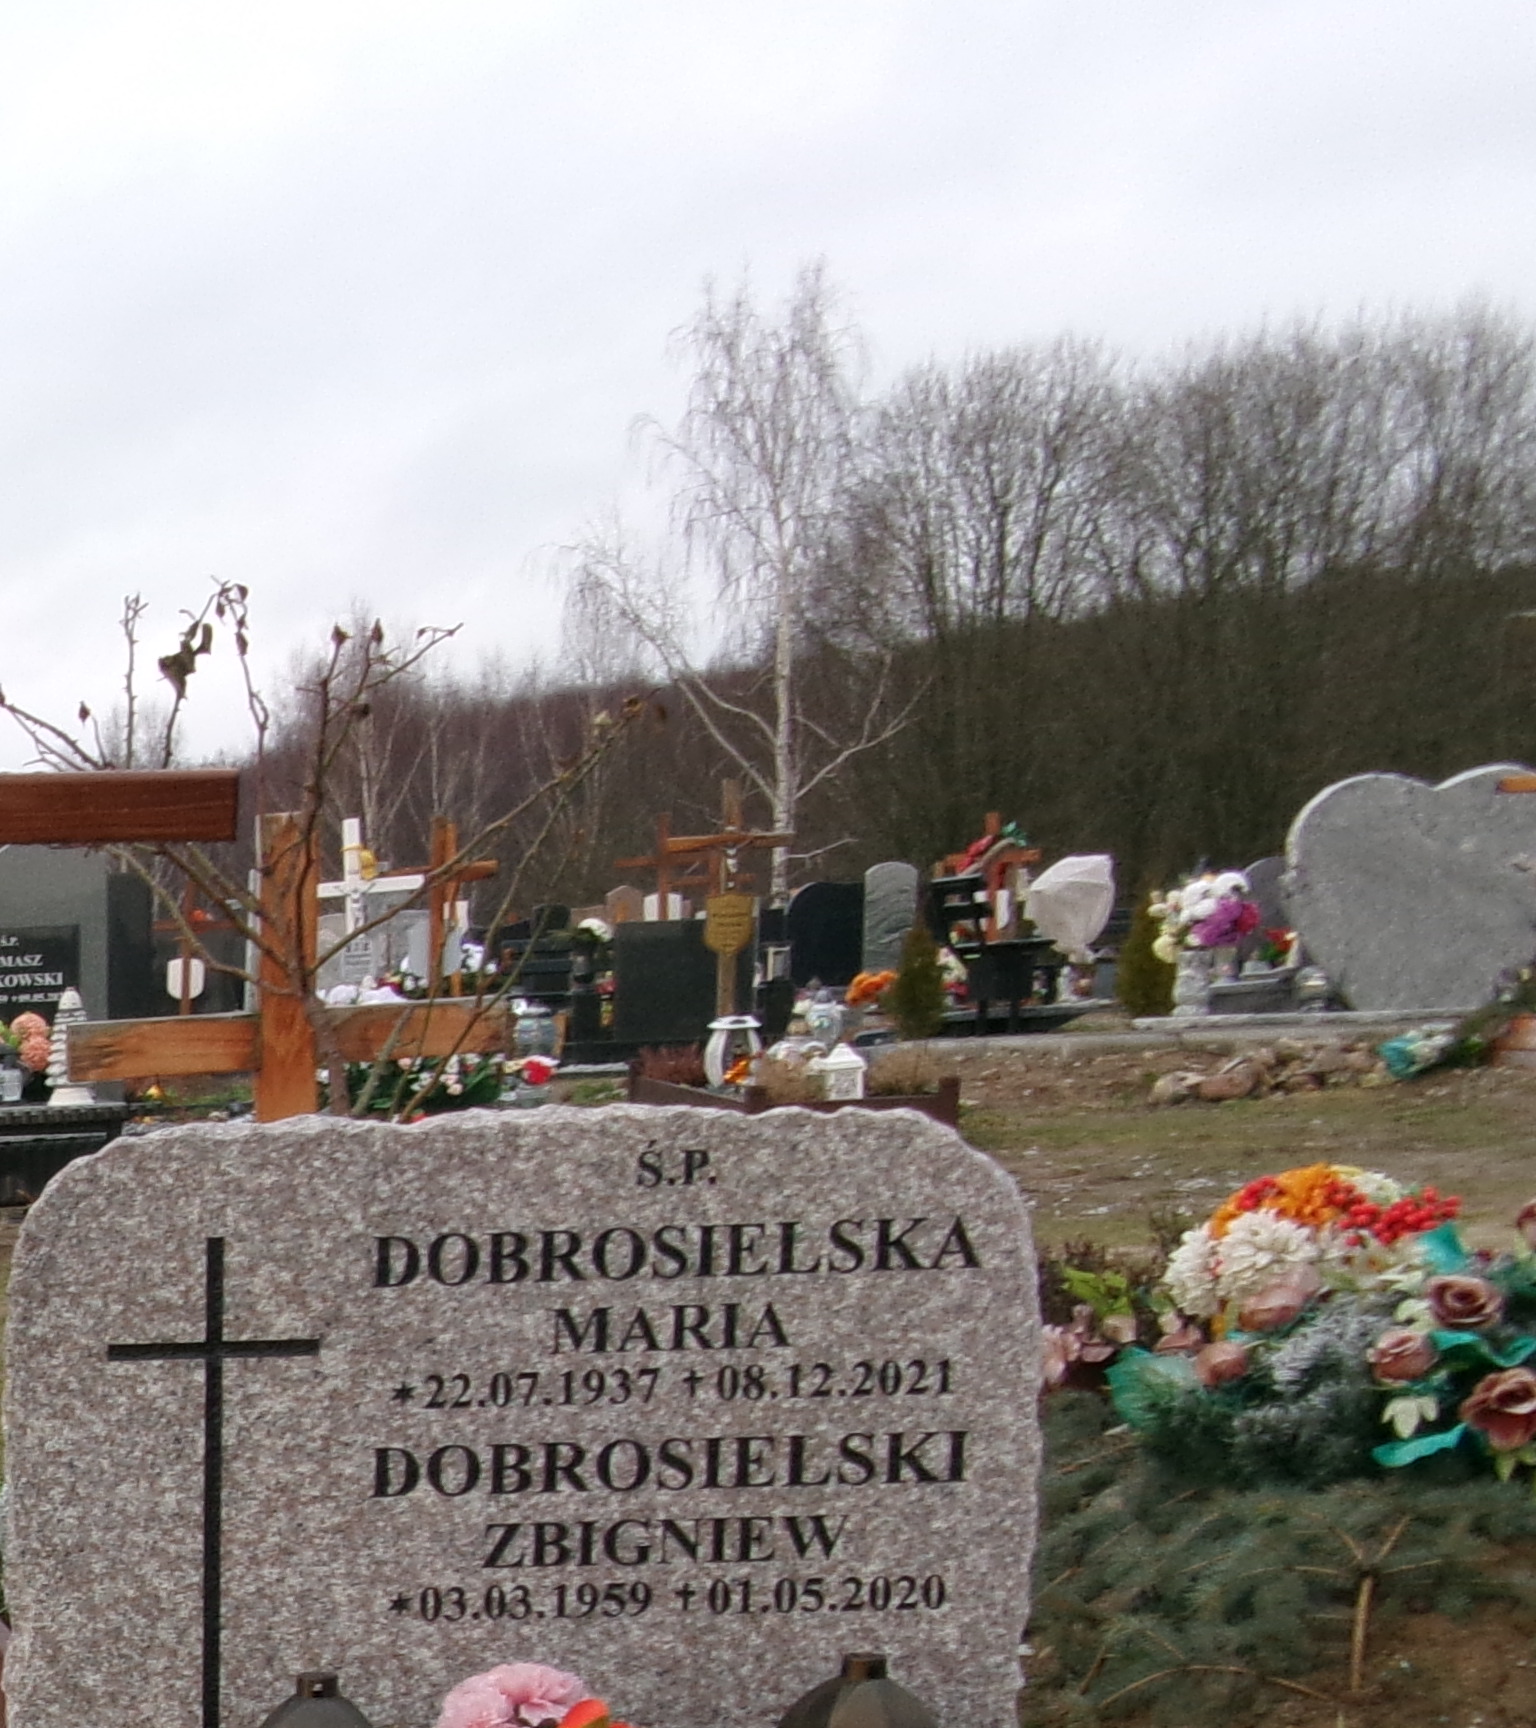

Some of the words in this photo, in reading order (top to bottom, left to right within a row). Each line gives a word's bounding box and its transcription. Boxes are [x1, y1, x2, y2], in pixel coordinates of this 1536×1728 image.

[372, 1214, 982, 1289] DOBROSIELSKA
[551, 1302, 789, 1356] MARIA
[371, 1430, 971, 1500] DOBROSIELSKI
[483, 1513, 851, 1569] ZBIGNIEW
